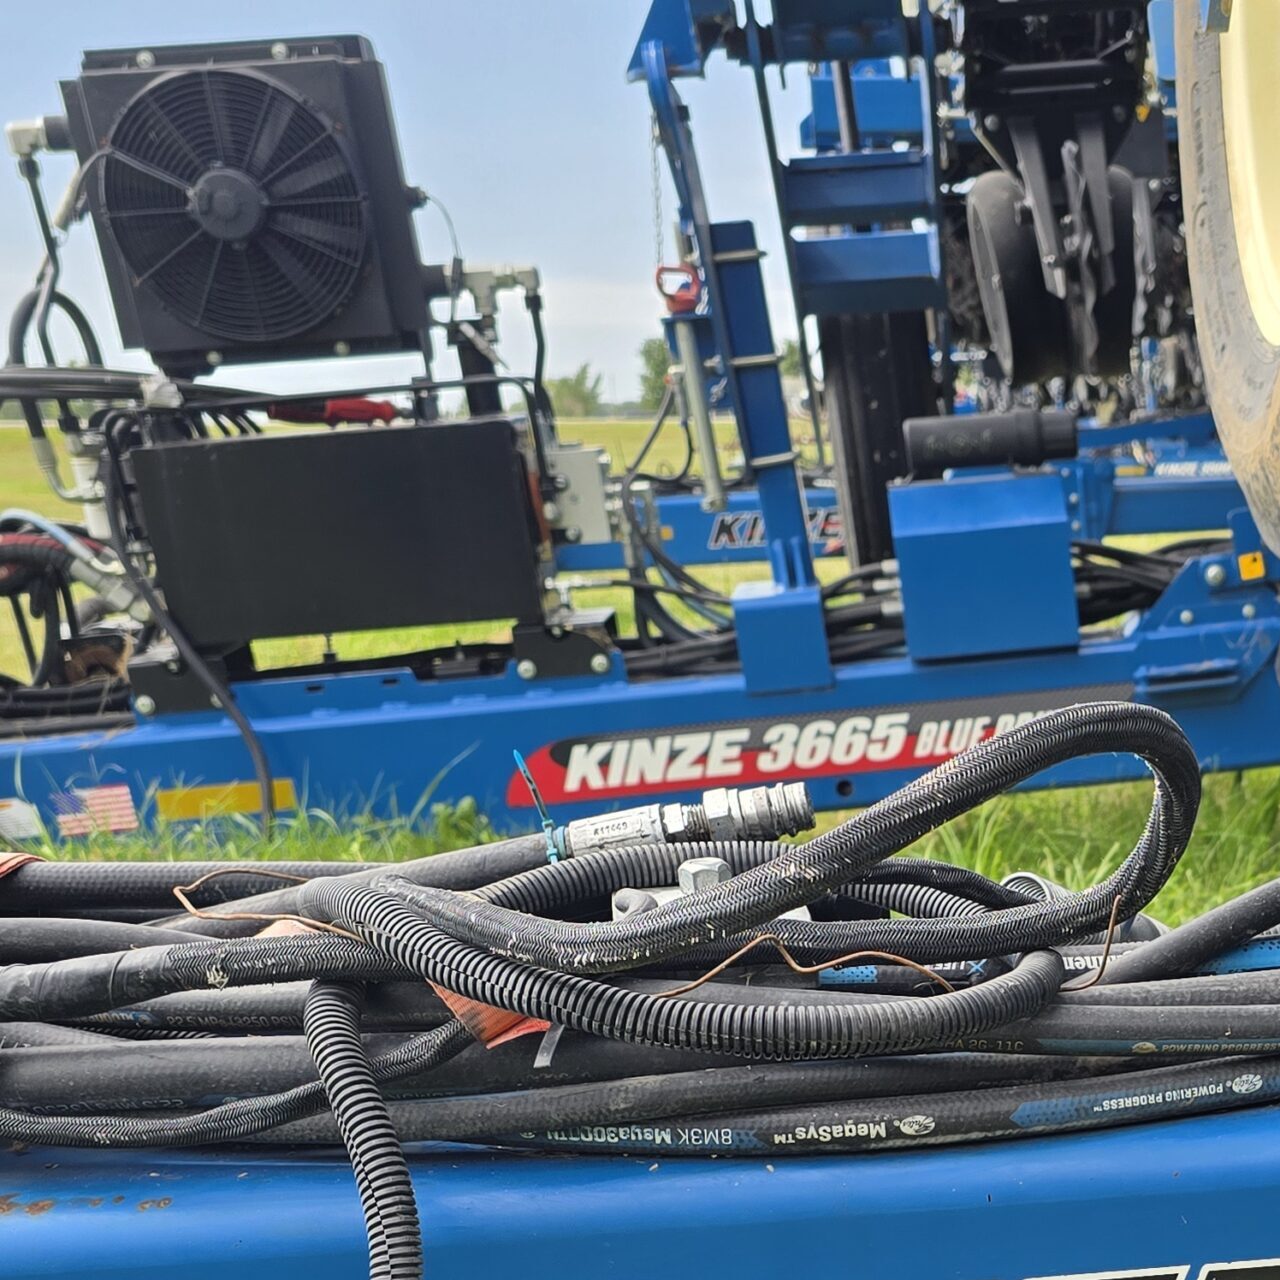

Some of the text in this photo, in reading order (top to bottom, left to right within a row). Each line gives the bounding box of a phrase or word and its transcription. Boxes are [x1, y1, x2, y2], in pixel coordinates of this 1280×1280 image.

[564, 727, 750, 792] KINZE
[756, 712, 910, 774] 3665
[914, 715, 992, 758] BLUE
[1165, 1083, 1224, 1102] POWERING
[677, 1127, 733, 1146] 8M3K
